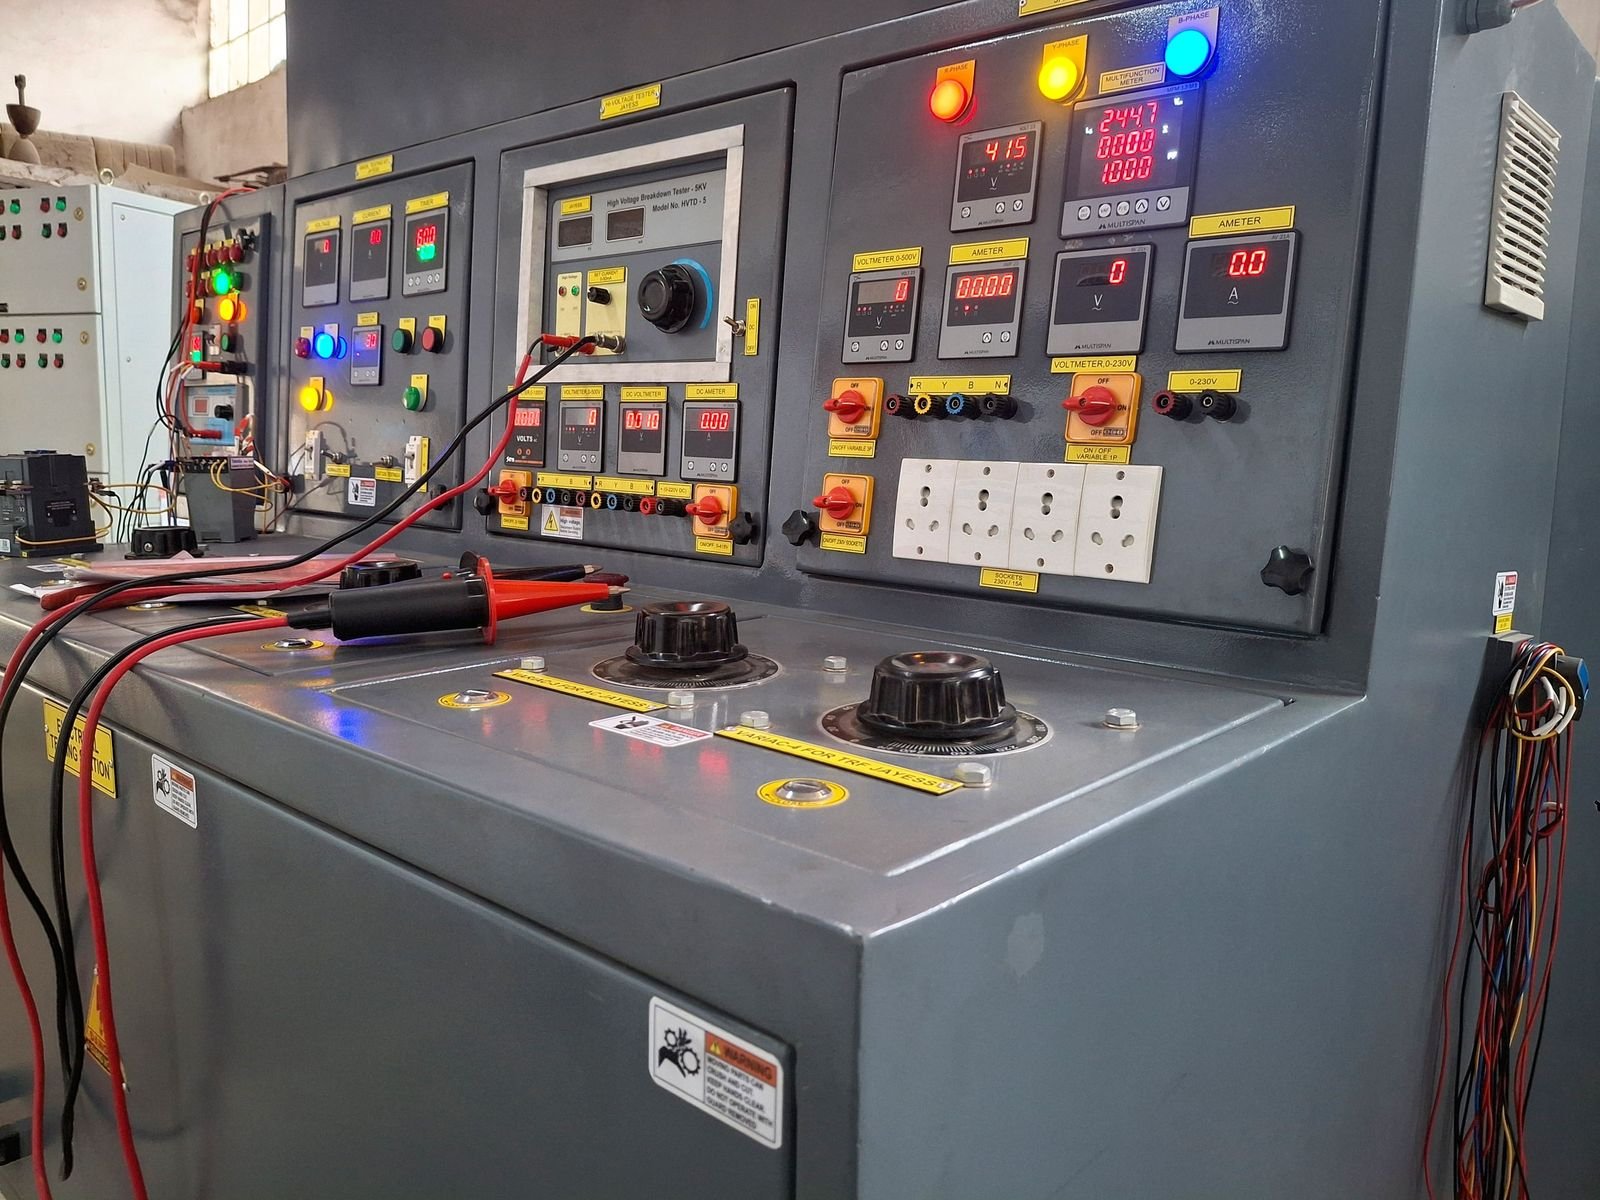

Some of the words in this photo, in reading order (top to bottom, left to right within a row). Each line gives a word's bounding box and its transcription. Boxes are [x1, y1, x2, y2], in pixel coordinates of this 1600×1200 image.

[1178, 11, 1210, 24] B-PHASE
[1052, 39, 1080, 50] Y-PHASE
[1105, 66, 1161, 82] MULTIFUNCTION
[1119, 76, 1144, 86] METER
[986, 136, 1027, 161] 415
[607, 199, 619, 209] High
[620, 195, 639, 206] Voltage
[640, 190, 671, 202] Breakdown
[673, 186, 690, 196] Tester
[694, 182, 708, 192] 5KV
[652, 203, 669, 213] Model
[670, 201, 679, 209] No.
[681, 197, 698, 208] HVTD
[1107, 219, 1146, 229] MULTISPAN
[1219, 216, 1261, 228] AMETER
[972, 247, 1004, 257] AMETER
[1109, 260, 1126, 284] 0
[895, 279, 908, 301] 0
[1229, 287, 1239, 300] A
[1094, 294, 1102, 306] V
[916, 381, 922, 389] R
[942, 381, 948, 389] Y
[968, 381, 974, 389] B
[995, 380, 1001, 389] N
[1097, 377, 1109, 385] OFF
[1189, 378, 1218, 386] 0-230V
[1091, 429, 1102, 437] OFF
[995, 572, 1023, 581] SOCKETS
[736, 730, 800, 751] VARIAC-4
[802, 745, 838, 759] FOR
[838, 756, 869, 768] TRF
[869, 762, 944, 787] JAYESS
